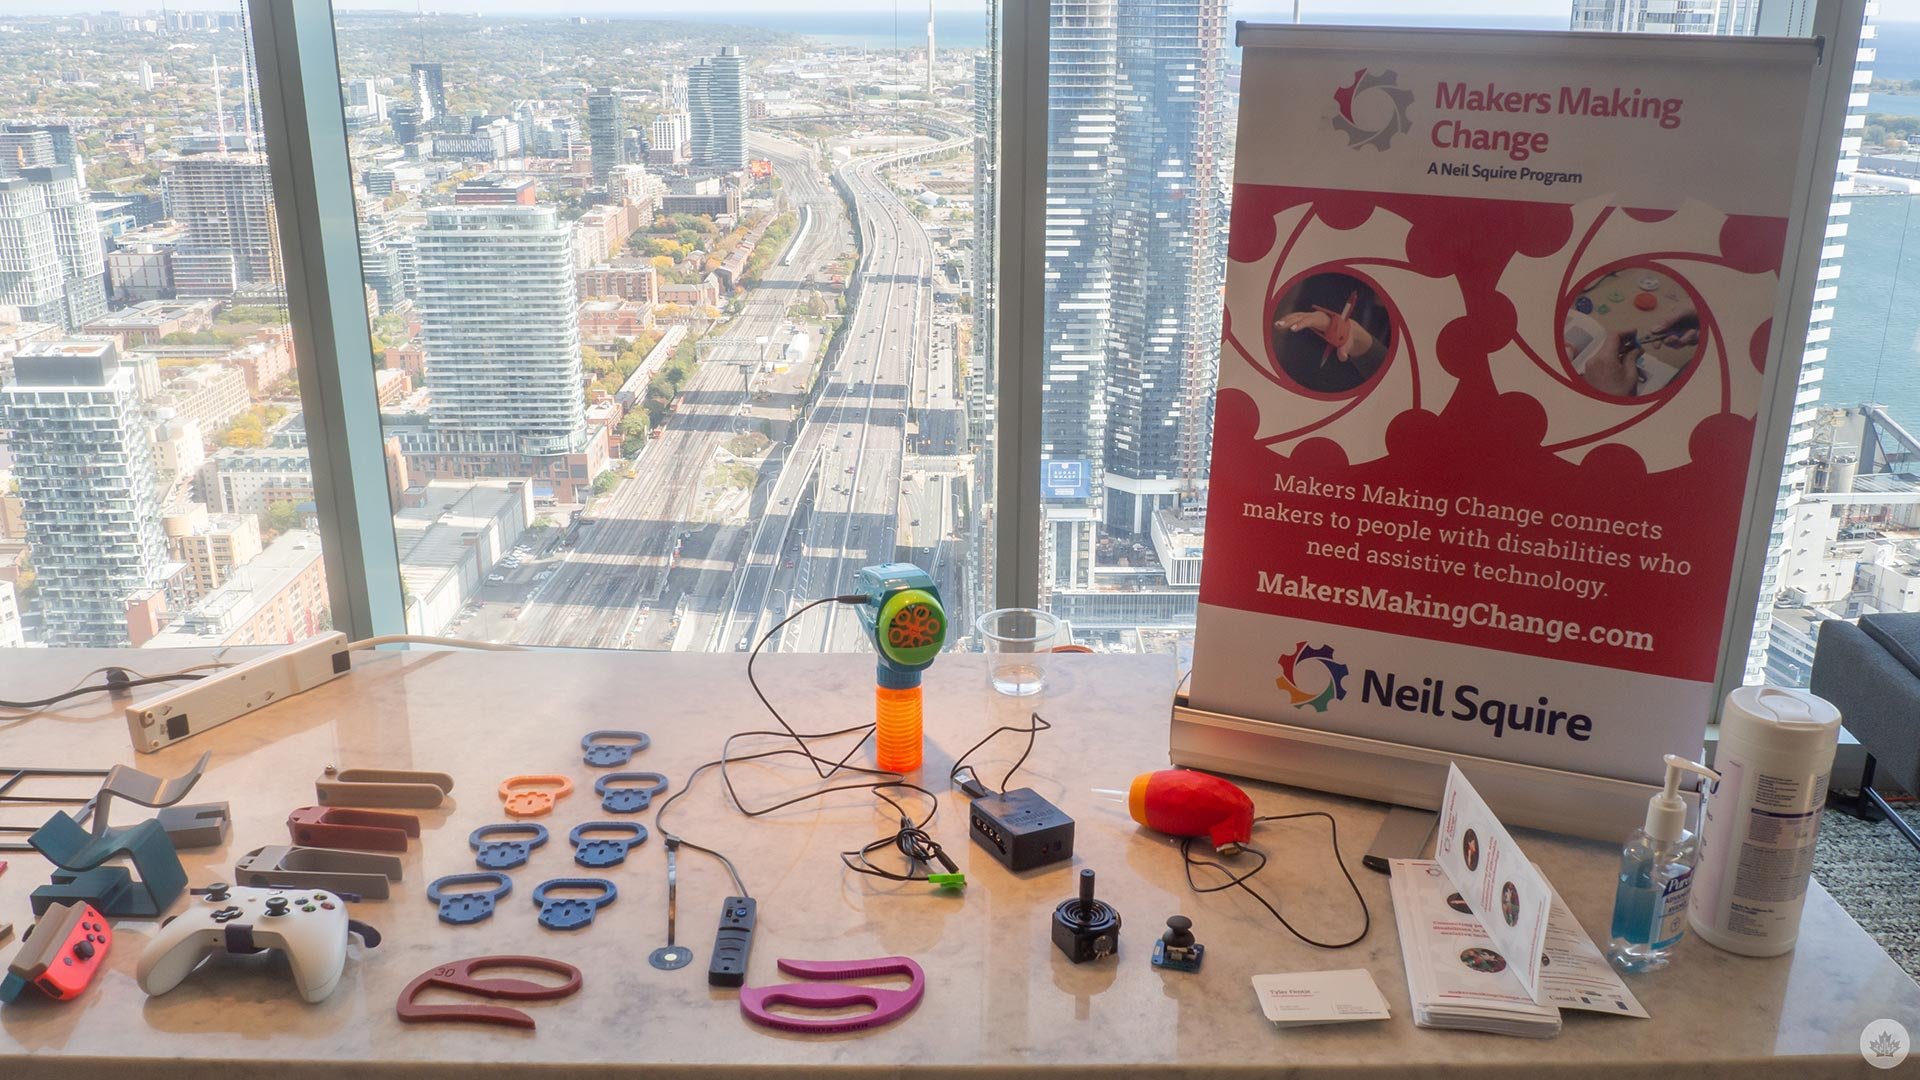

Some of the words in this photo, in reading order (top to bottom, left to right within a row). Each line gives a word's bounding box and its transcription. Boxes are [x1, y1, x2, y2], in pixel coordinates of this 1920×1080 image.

[1435, 82, 1551, 114] Makers
[1558, 86, 1683, 129] Making
[1431, 119, 1549, 161] Change
[1427, 162, 1438, 175] A
[1441, 163, 1469, 177] Neil
[1472, 165, 1517, 181] Squire
[1520, 167, 1583, 186] Program
[1274, 473, 1356, 500] Makers
[1361, 484, 1449, 517] Making
[1455, 496, 1544, 528] Change
[1551, 511, 1663, 540] connects
[1242, 502, 1324, 526] makers
[1330, 511, 1351, 530] to
[1356, 517, 1432, 542] people
[1439, 526, 1490, 549] with
[1497, 532, 1631, 568] disabilities
[1639, 552, 1691, 575] who
[1306, 540, 1360, 561] need
[1366, 549, 1467, 576] assistive
[1473, 561, 1608, 600] technology.
[1256, 570, 1654, 652] MakersMakingChange.com
[1361, 668, 1446, 718] Neil
[1451, 684, 1593, 742] Squire
[435, 968, 456, 978] 30
